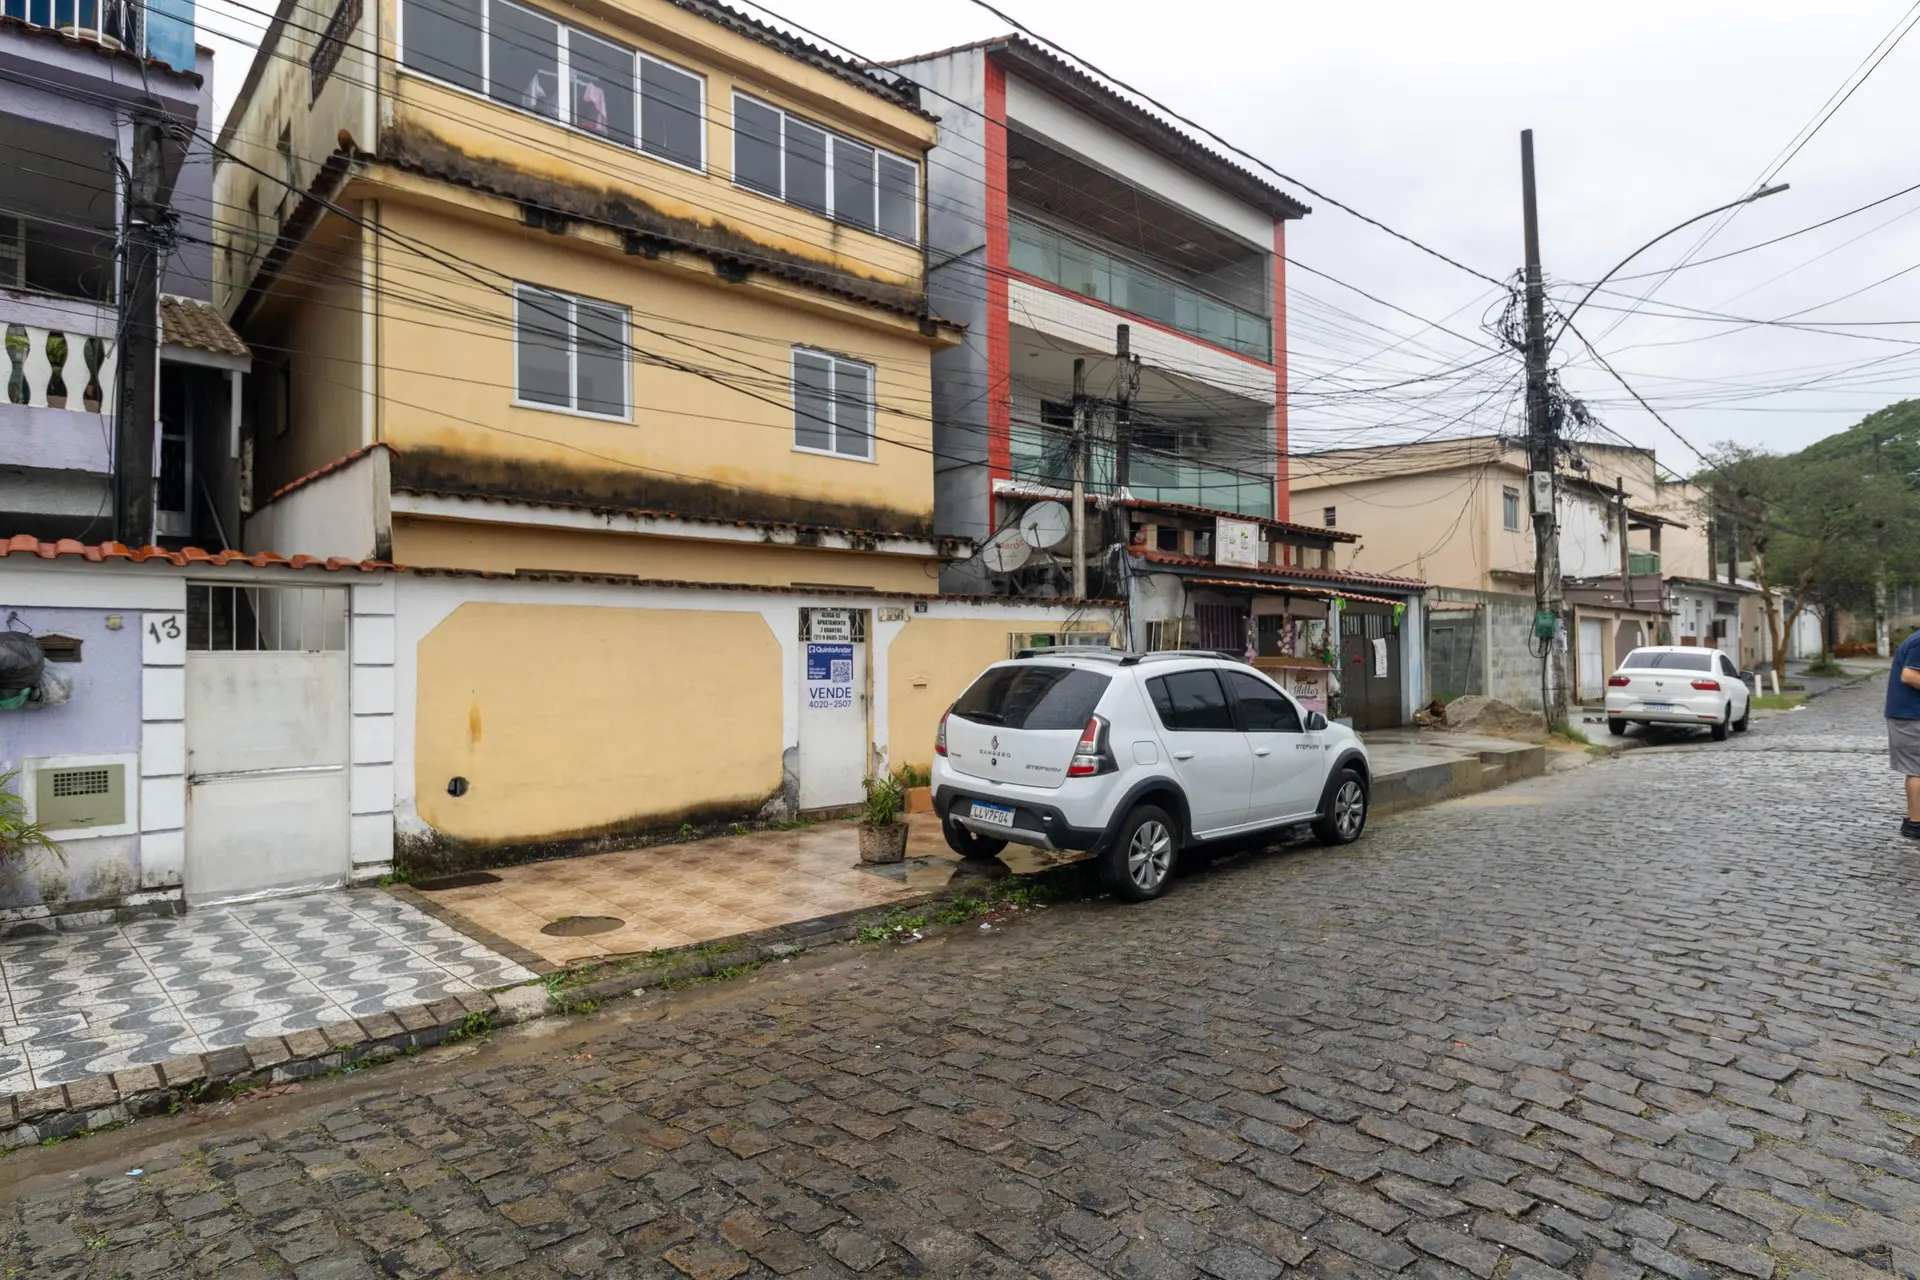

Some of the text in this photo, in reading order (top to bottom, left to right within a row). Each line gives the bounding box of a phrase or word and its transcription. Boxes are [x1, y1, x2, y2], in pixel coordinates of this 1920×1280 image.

[149, 614, 181, 644] 13
[809, 687, 852, 699] VENDE
[808, 700, 852, 708] 4020-2507
[979, 748, 1012, 758] SANDERO
[1025, 764, 1062, 773] STEPWAY
[973, 806, 1008, 824] LLY7F04
